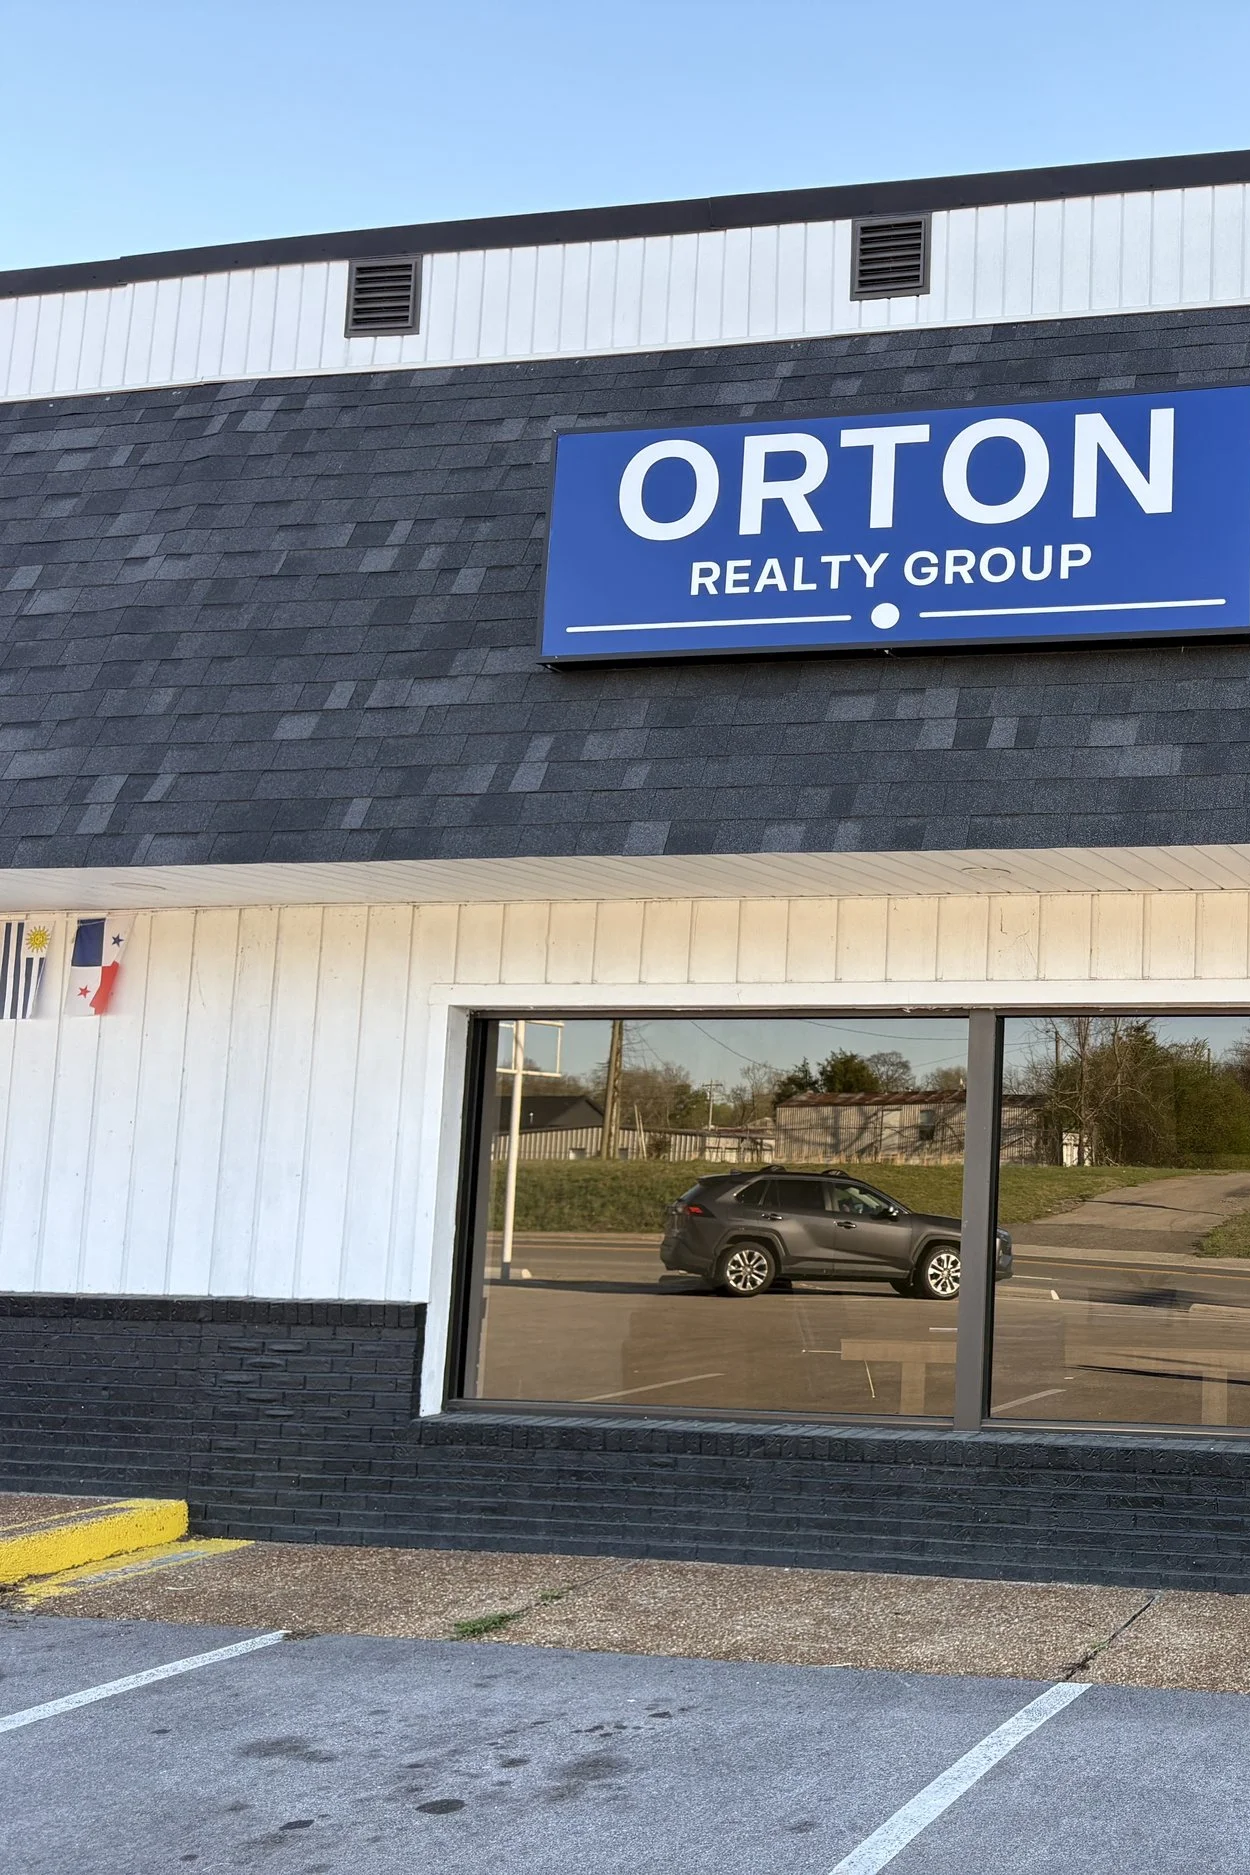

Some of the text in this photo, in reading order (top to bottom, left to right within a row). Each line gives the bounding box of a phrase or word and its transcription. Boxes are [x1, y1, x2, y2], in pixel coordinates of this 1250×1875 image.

[618, 407, 1175, 542] ORTON
[690, 543, 1092, 597] REALTY GROUP
